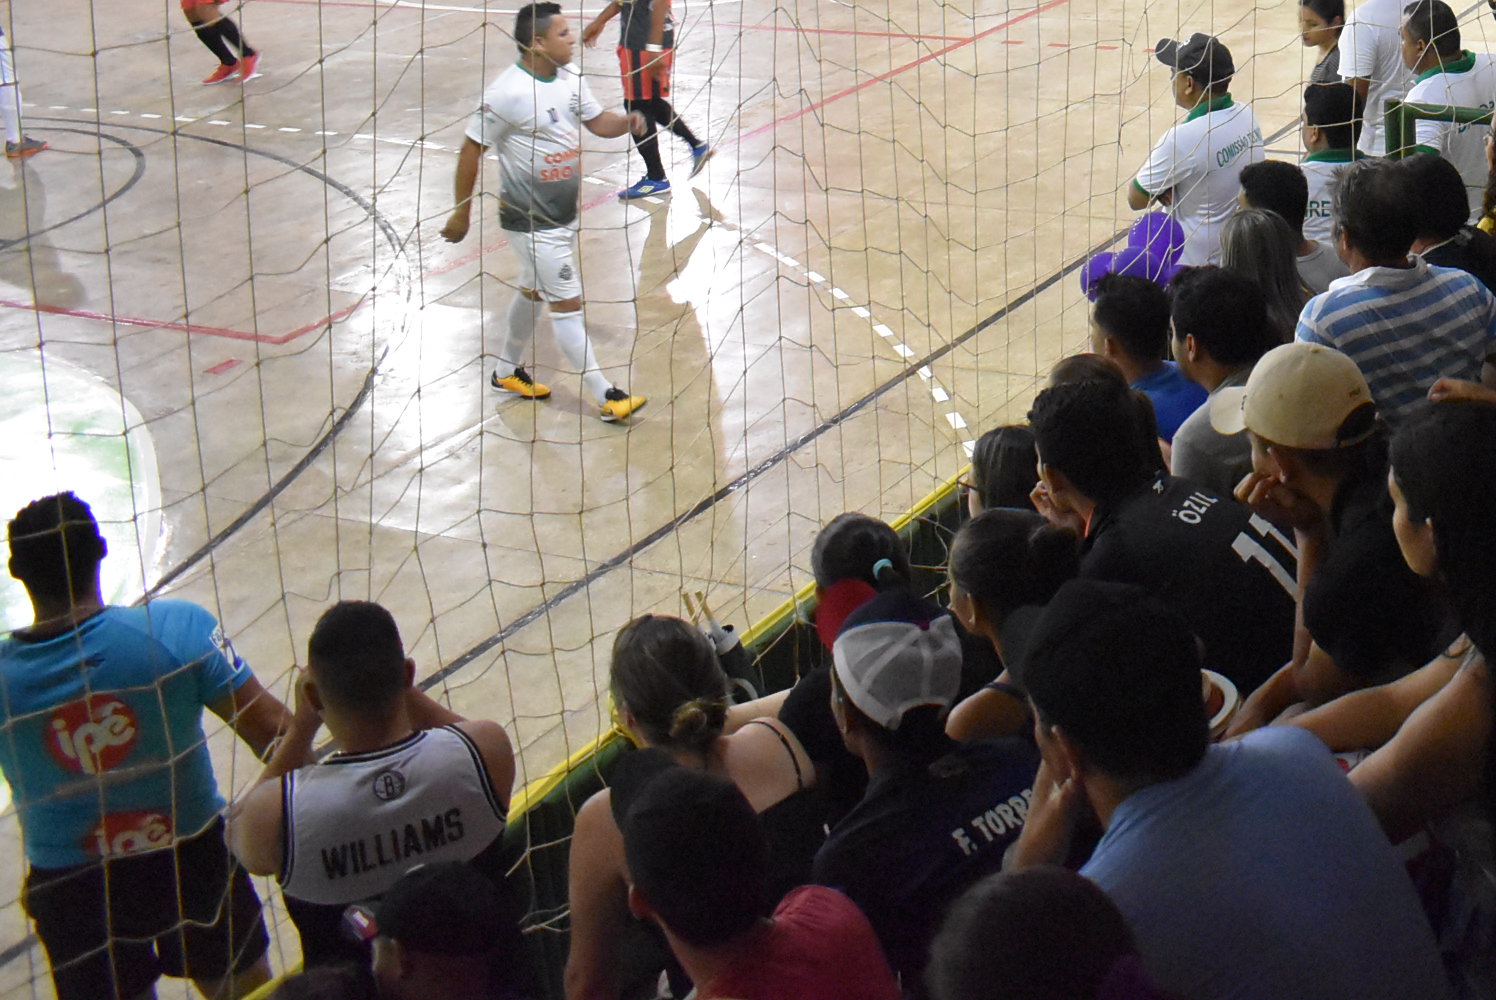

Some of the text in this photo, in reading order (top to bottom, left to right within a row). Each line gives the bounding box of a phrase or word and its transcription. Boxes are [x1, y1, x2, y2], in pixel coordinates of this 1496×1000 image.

[1216, 134, 1249, 168] COMISSÃO
[1171, 491, 1219, 524] ÖZIL
[321, 807, 465, 881] WILLIAMS
[951, 827, 978, 856] F.
